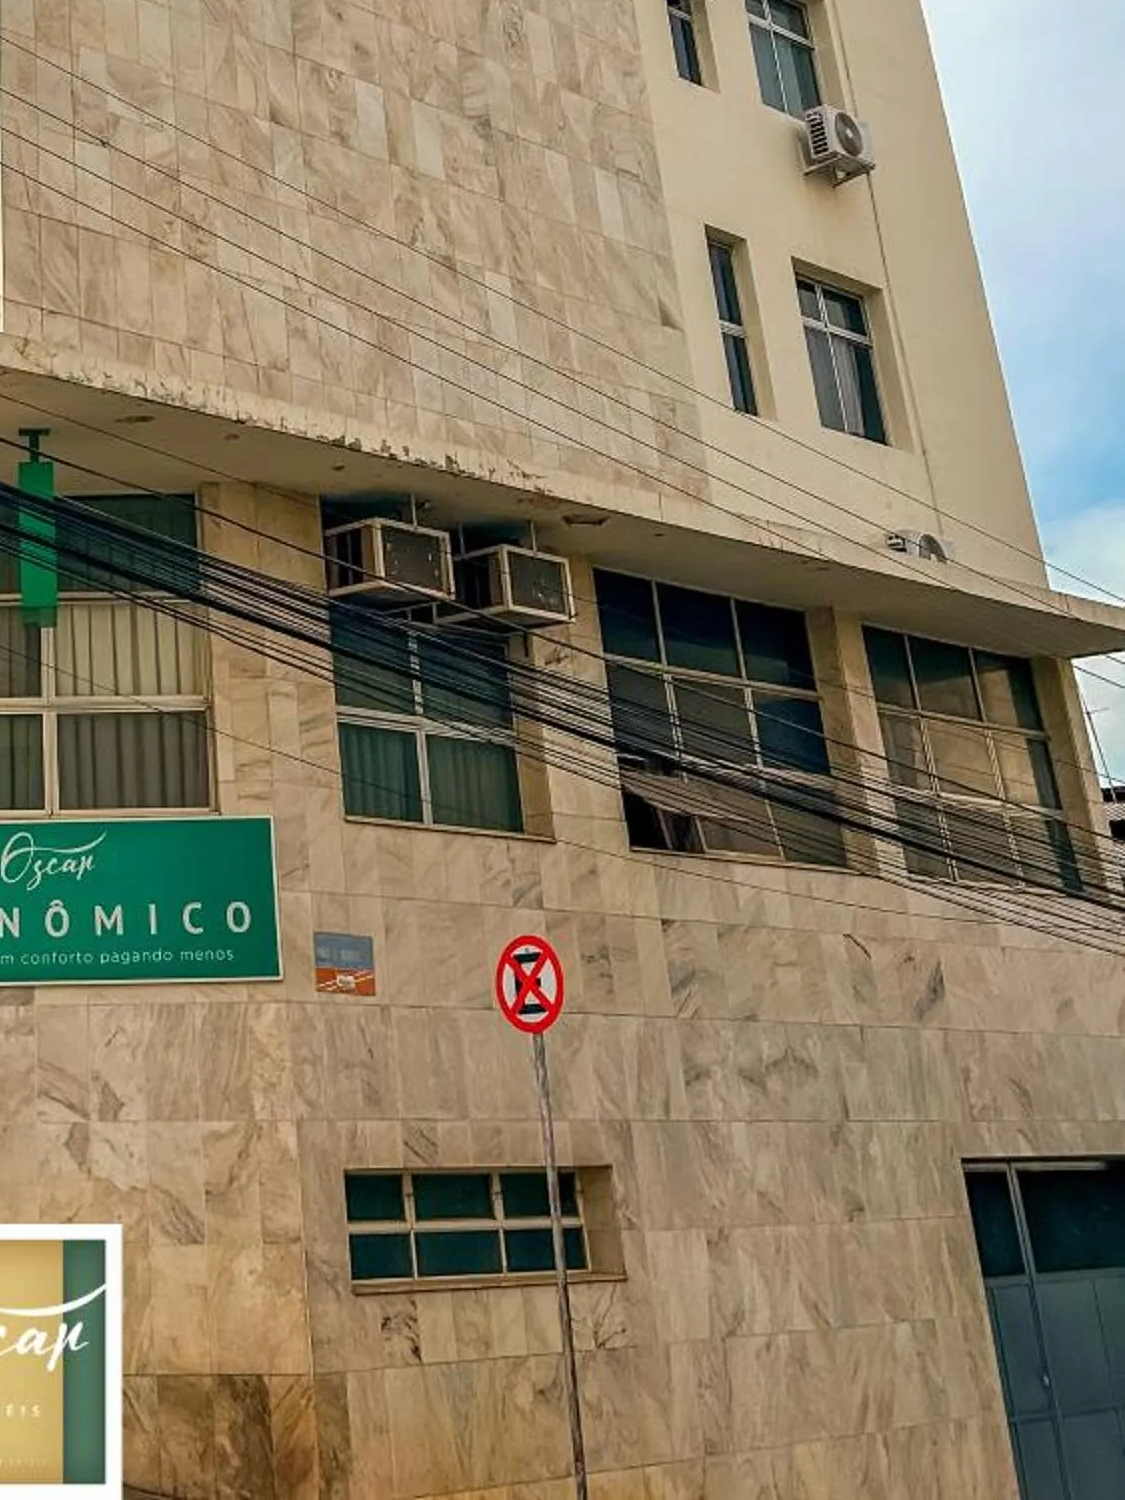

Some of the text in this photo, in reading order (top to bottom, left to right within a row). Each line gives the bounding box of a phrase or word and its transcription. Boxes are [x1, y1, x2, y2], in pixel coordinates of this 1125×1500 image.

[0, 831, 107, 891] Oscar
[20, 950, 94, 966] conforto
[100, 948, 173, 965] pagando
[180, 948, 235, 962] menos
